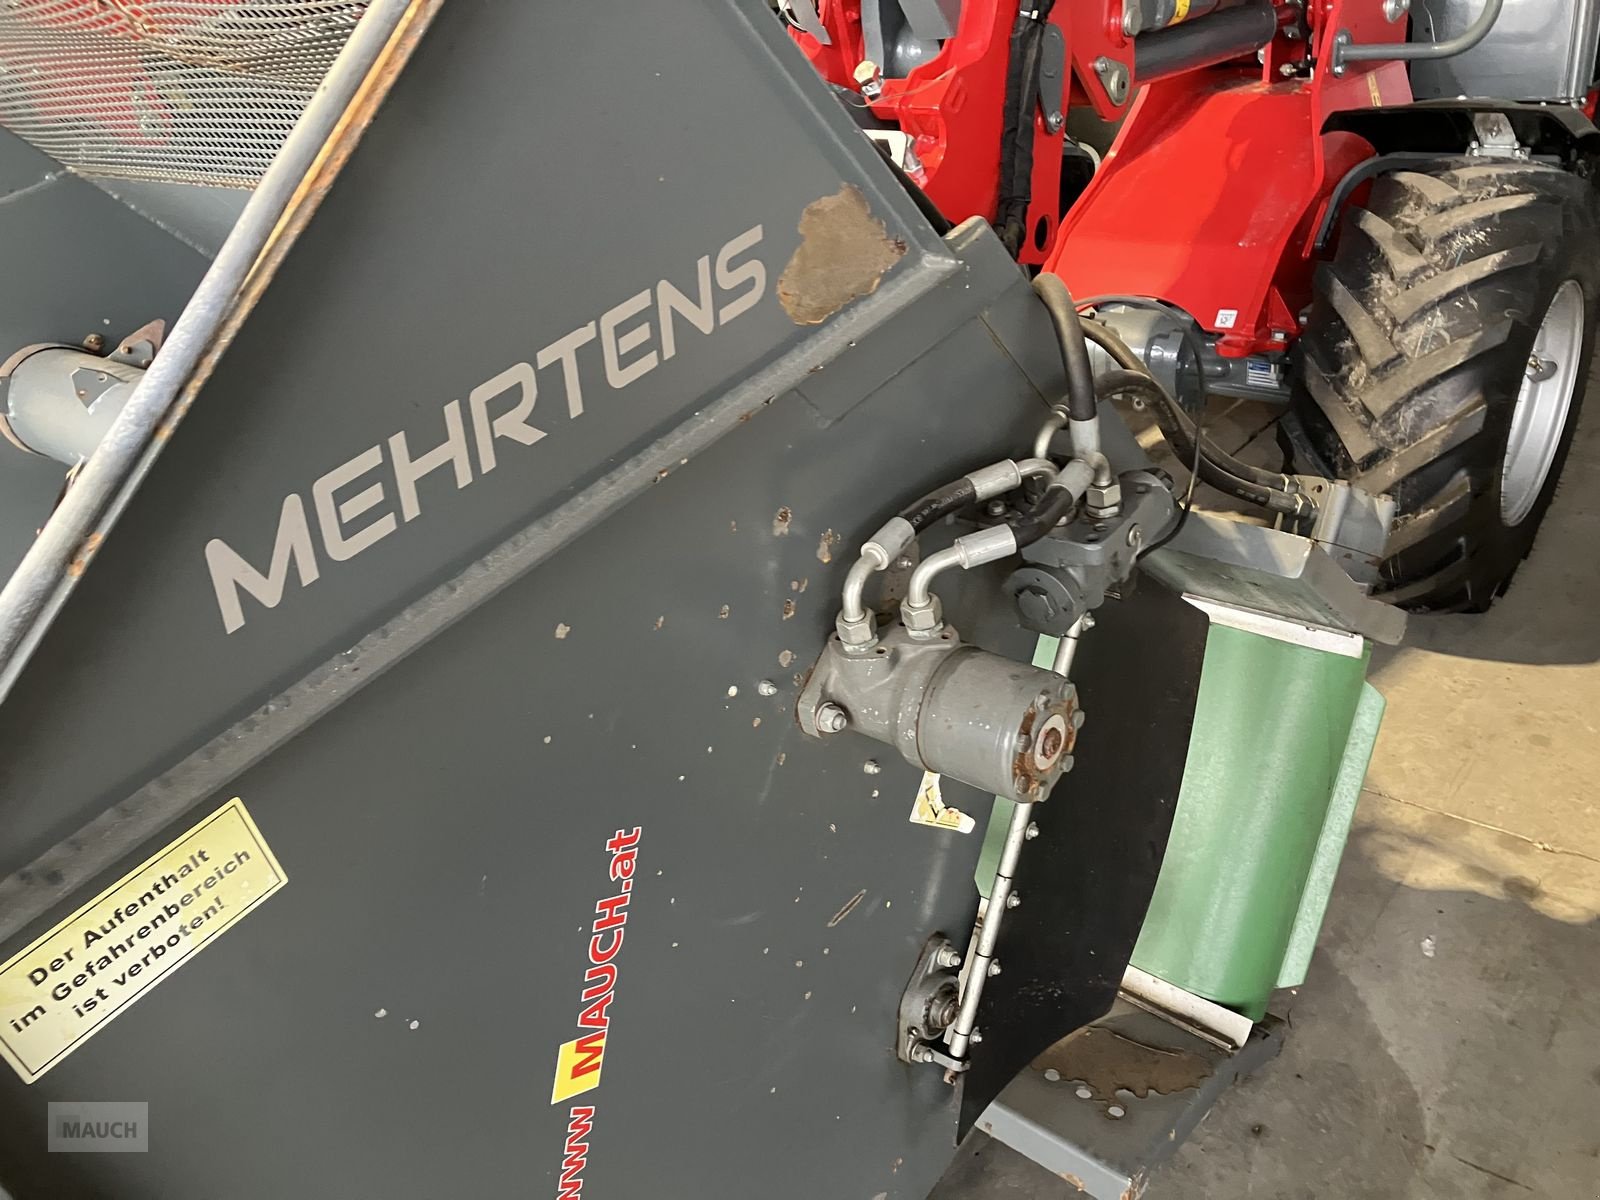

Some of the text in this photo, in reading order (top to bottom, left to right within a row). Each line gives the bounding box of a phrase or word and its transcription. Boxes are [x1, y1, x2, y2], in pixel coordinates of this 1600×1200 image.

[204, 224, 766, 634] MEHRTENS
[10, 849, 251, 1033] im Gefahrenbereich
[28, 849, 210, 987] Der Aufenthalt
[72, 896, 225, 1018] ist verboten!
[570, 826, 642, 1080] MAUCH.at
